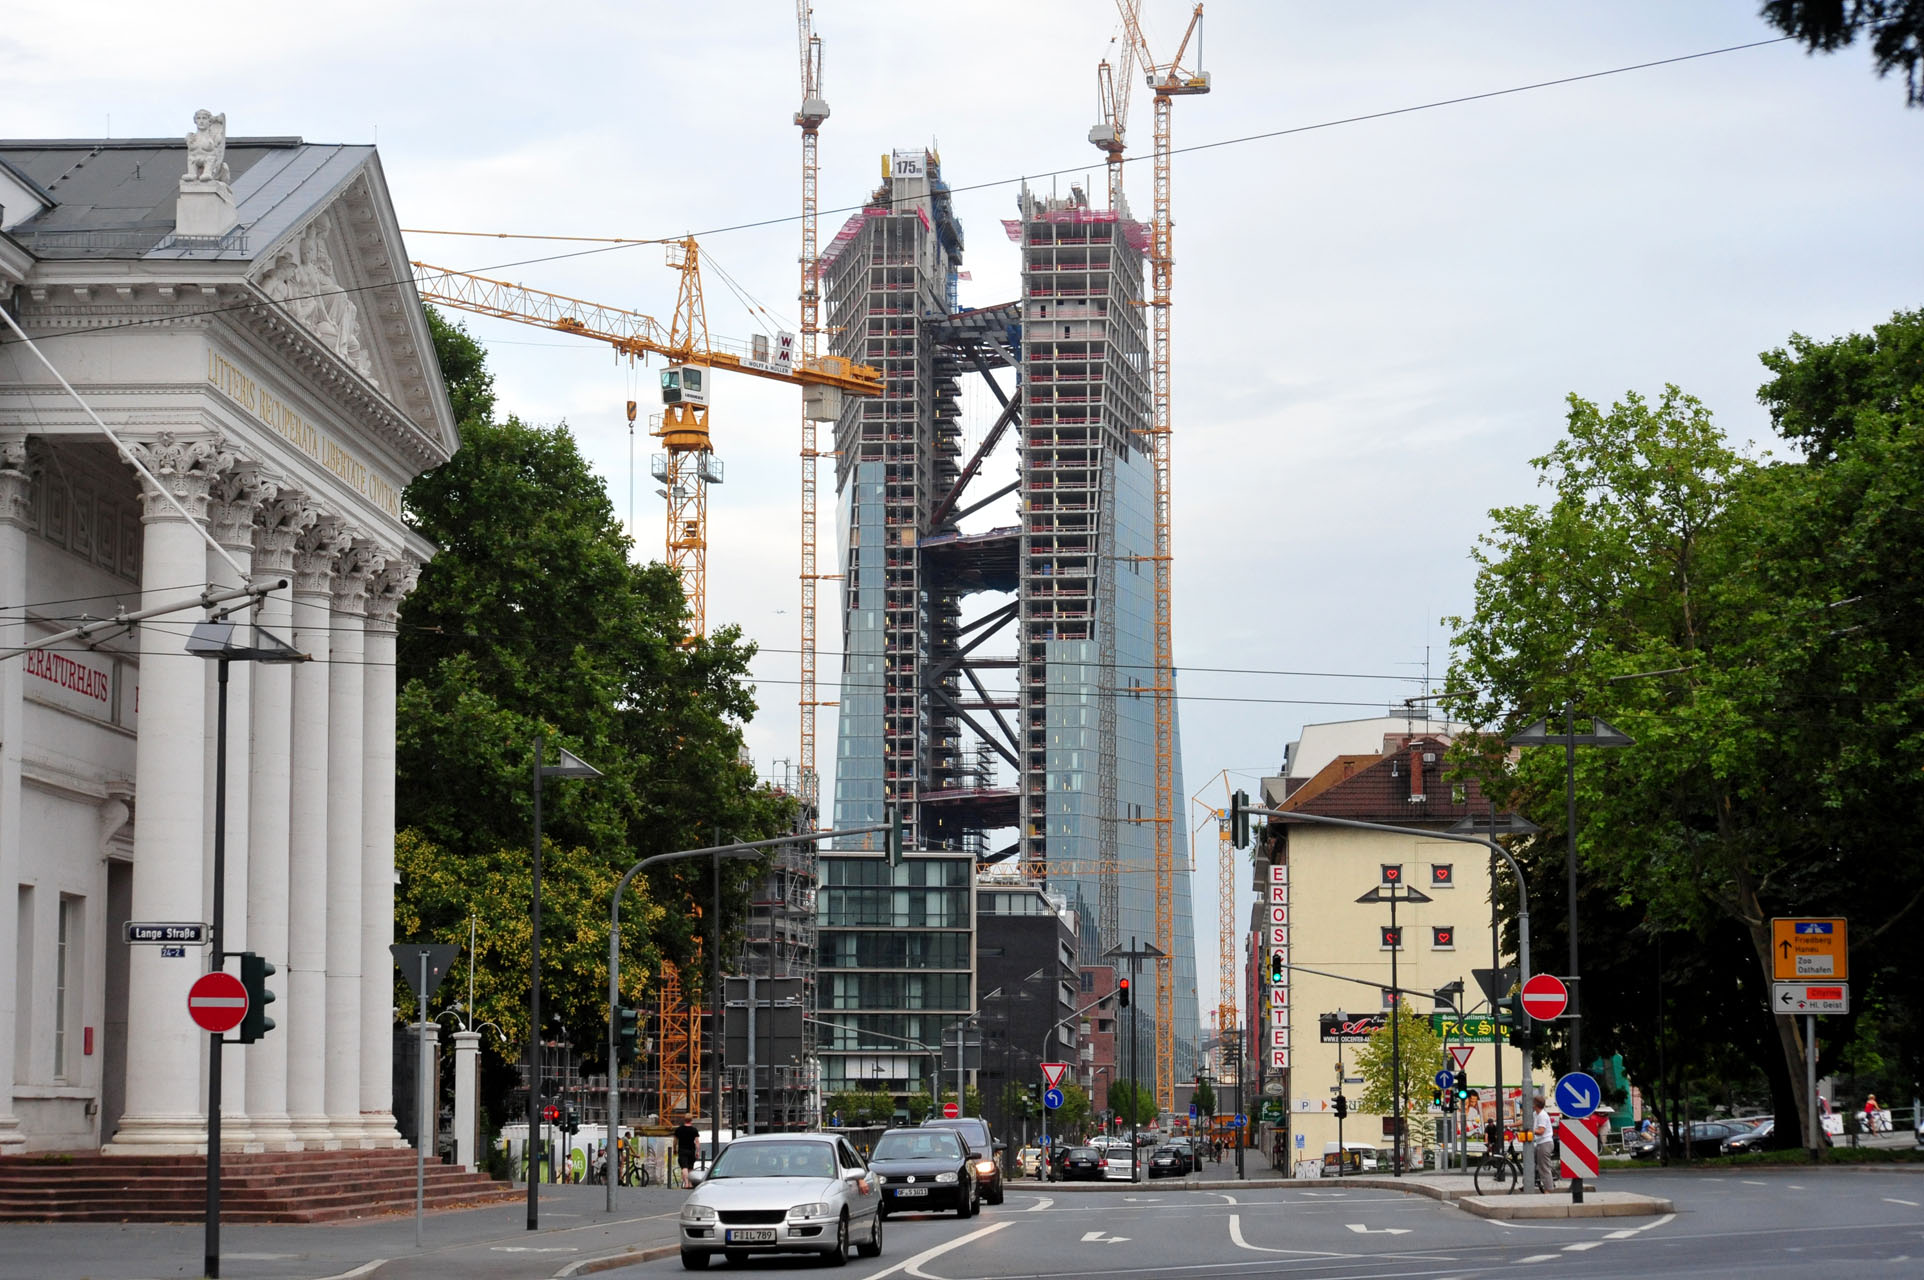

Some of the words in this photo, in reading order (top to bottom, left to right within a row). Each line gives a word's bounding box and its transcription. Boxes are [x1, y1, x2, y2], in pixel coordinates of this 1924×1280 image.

[781, 336, 792, 347] W
[779, 350, 790, 361] M
[207, 348, 256, 411] LITTERIS
[259, 387, 319, 460] RECUPERATA
[322, 436, 367, 495] LIBERTATE
[369, 473, 398, 517] CIVITAS
[23, 642, 108, 702] ERATURHAUS
[136, 928, 162, 940] Lange
[166, 928, 195, 940] Straße
[1273, 867, 1285, 1066] EROSNTER
[1798, 966, 1832, 974] Osthafen
[757, 1231, 772, 1240] 789
